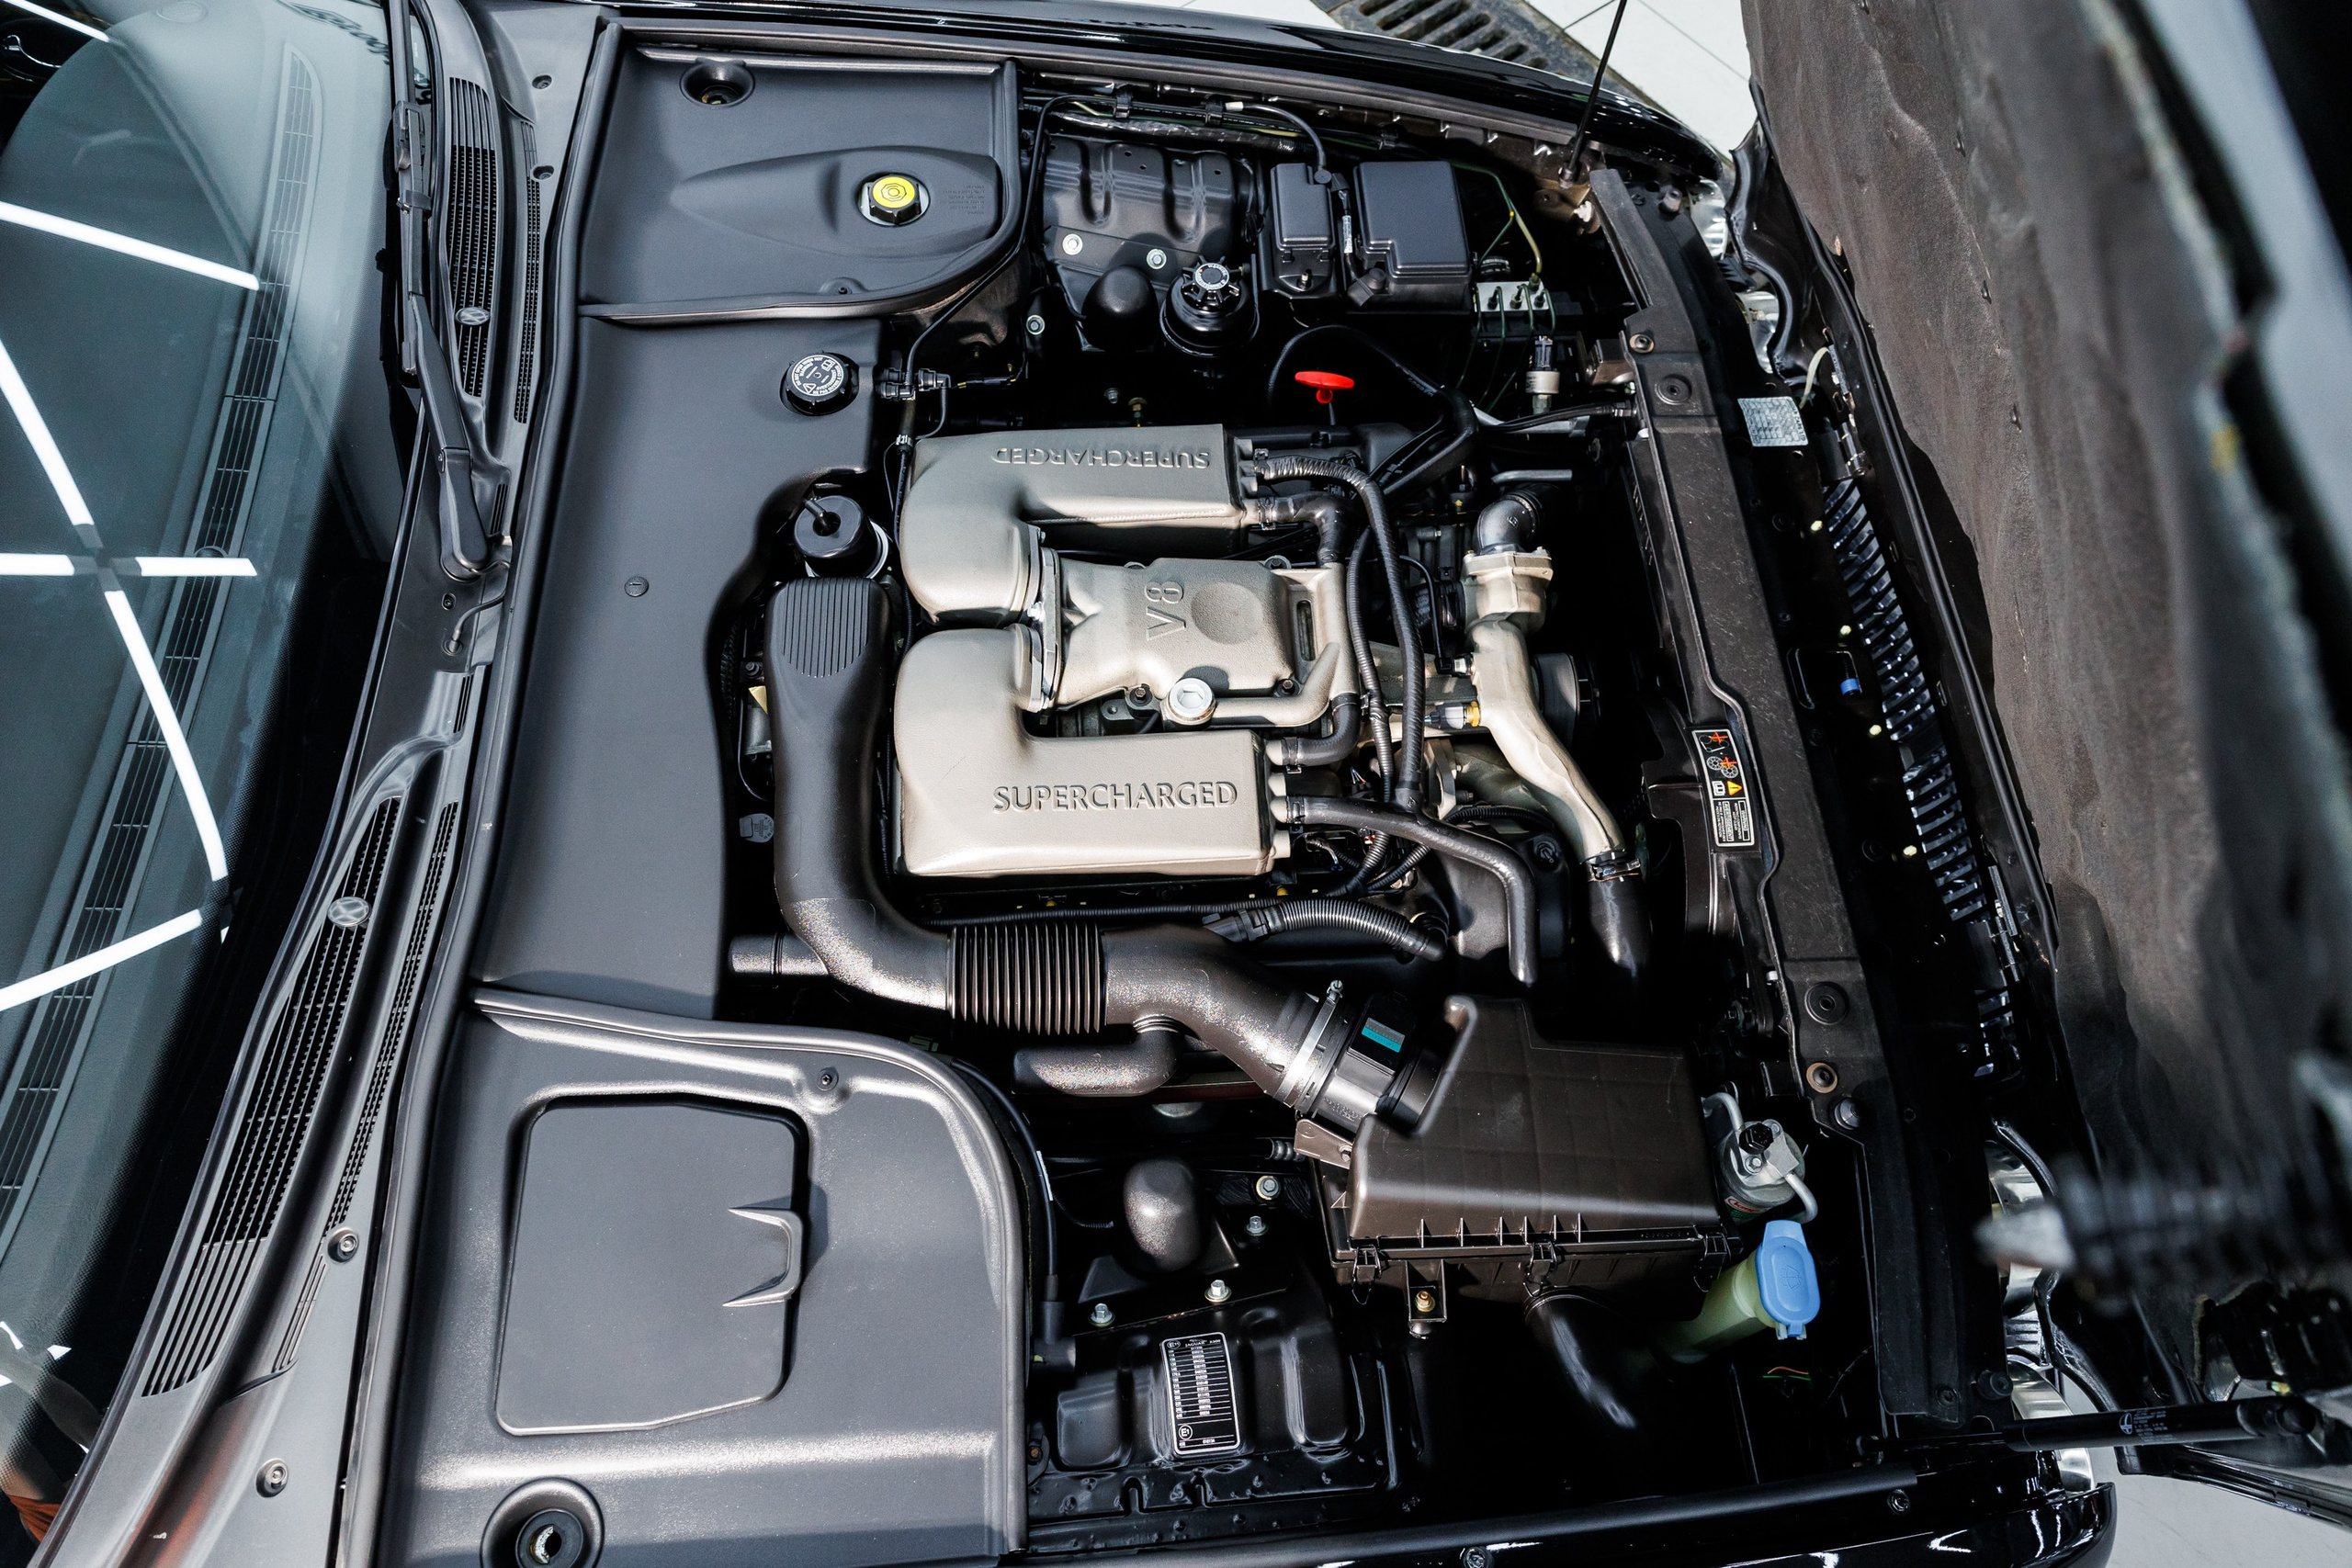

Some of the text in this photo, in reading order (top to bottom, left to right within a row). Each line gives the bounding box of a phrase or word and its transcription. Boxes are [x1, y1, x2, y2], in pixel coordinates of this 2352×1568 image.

[991, 446, 1210, 469] SUPERCHARGED
[1144, 581, 1188, 641] V8
[992, 780, 1238, 814] SUPERCHARGED
